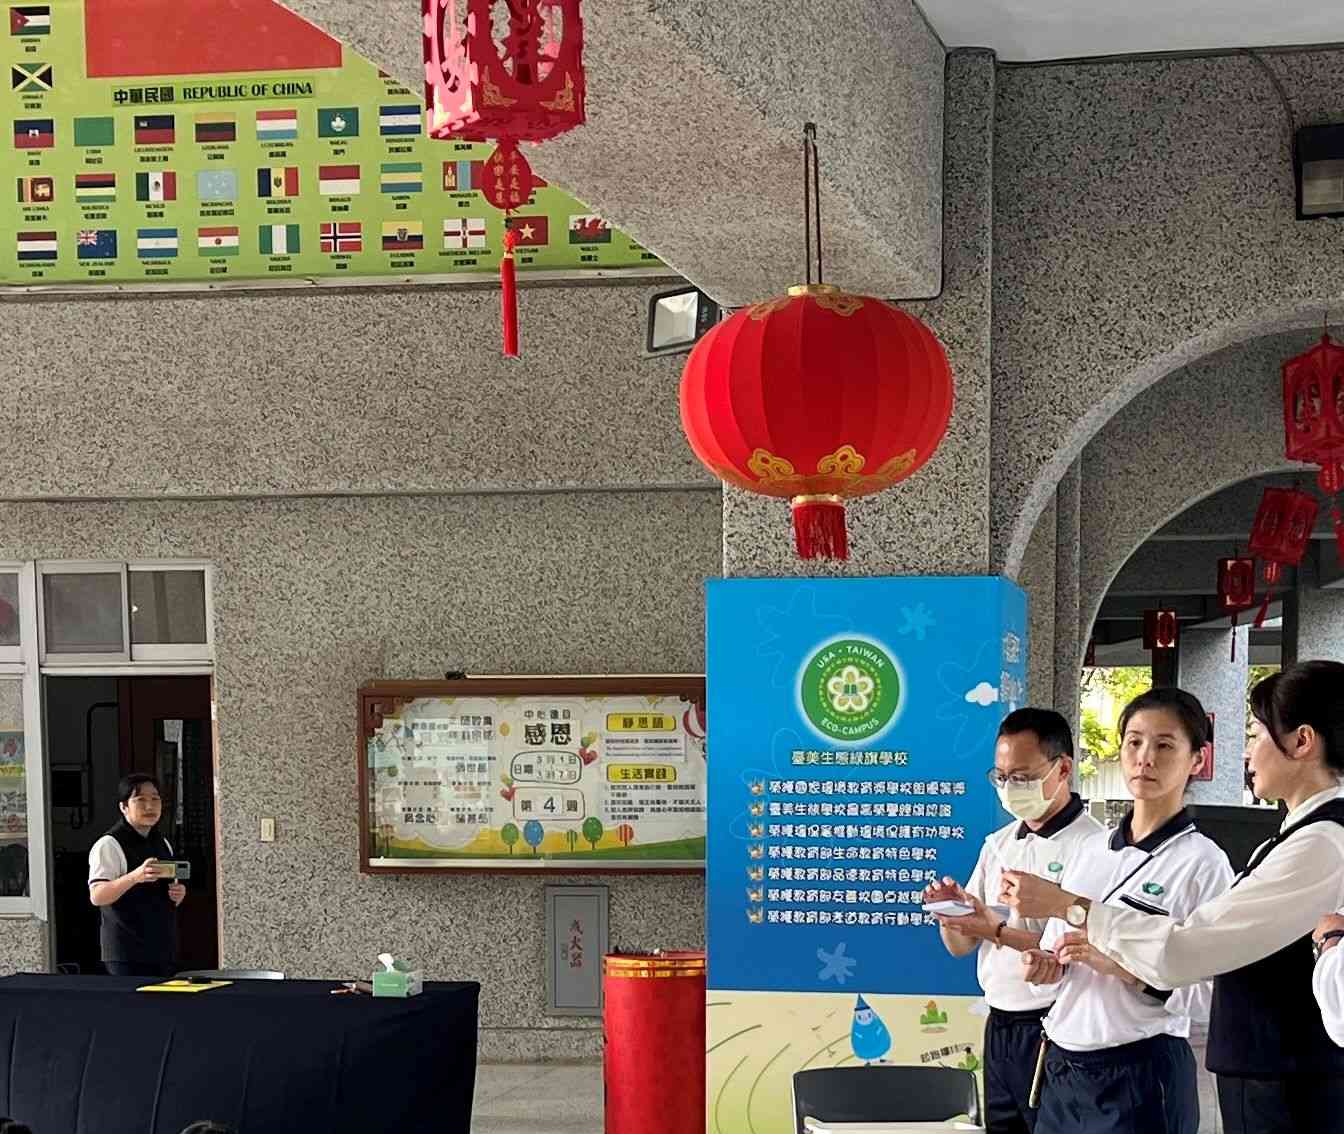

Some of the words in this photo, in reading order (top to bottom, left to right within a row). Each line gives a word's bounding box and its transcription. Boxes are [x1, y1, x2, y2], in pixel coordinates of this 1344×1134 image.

[113, 86, 175, 104] 中華民國
[182, 84, 245, 100] REPUBLIC
[251, 83, 268, 97] OF
[272, 81, 313, 96] CHINA
[817, 650, 836, 669] USA
[846, 645, 885, 669] TAIWAN
[524, 722, 572, 746] 感恩
[821, 717, 880, 735] ECO-CAMPUS
[791, 751, 908, 766] 臺美生態綠旗學校
